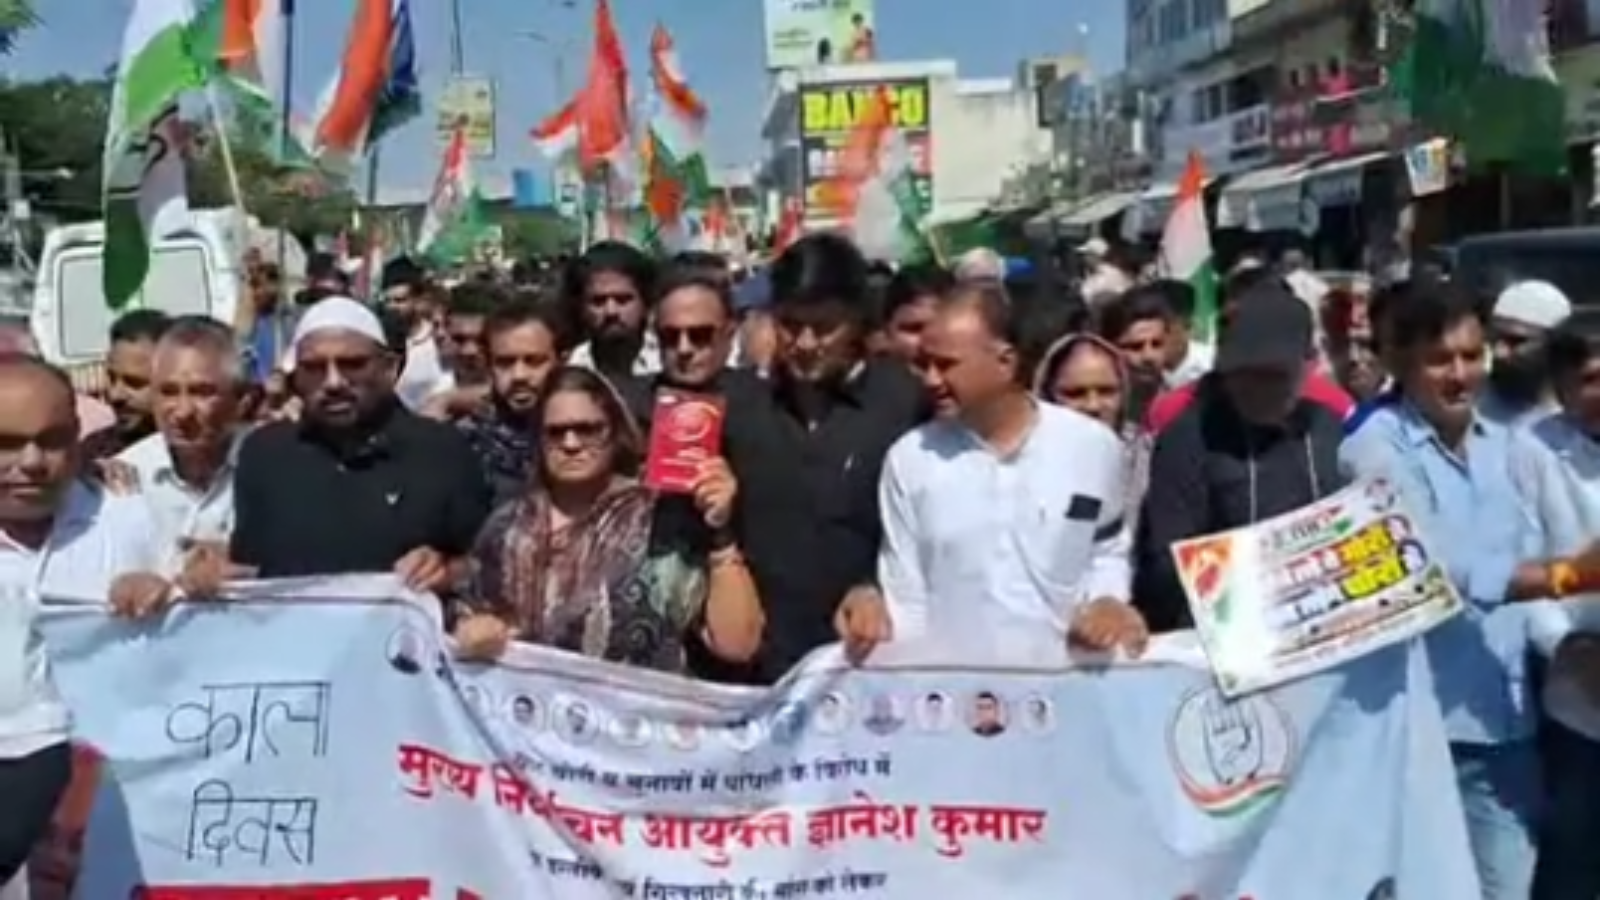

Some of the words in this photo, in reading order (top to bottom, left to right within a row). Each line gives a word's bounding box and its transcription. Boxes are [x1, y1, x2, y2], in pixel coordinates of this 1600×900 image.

[186, 779, 318, 867] दिवस
[399, 744, 483, 799] मुख्य
[640, 811, 791, 867] आयुक्त
[806, 790, 917, 850] ज्ञानेश
[930, 805, 1046, 857] कुमार
